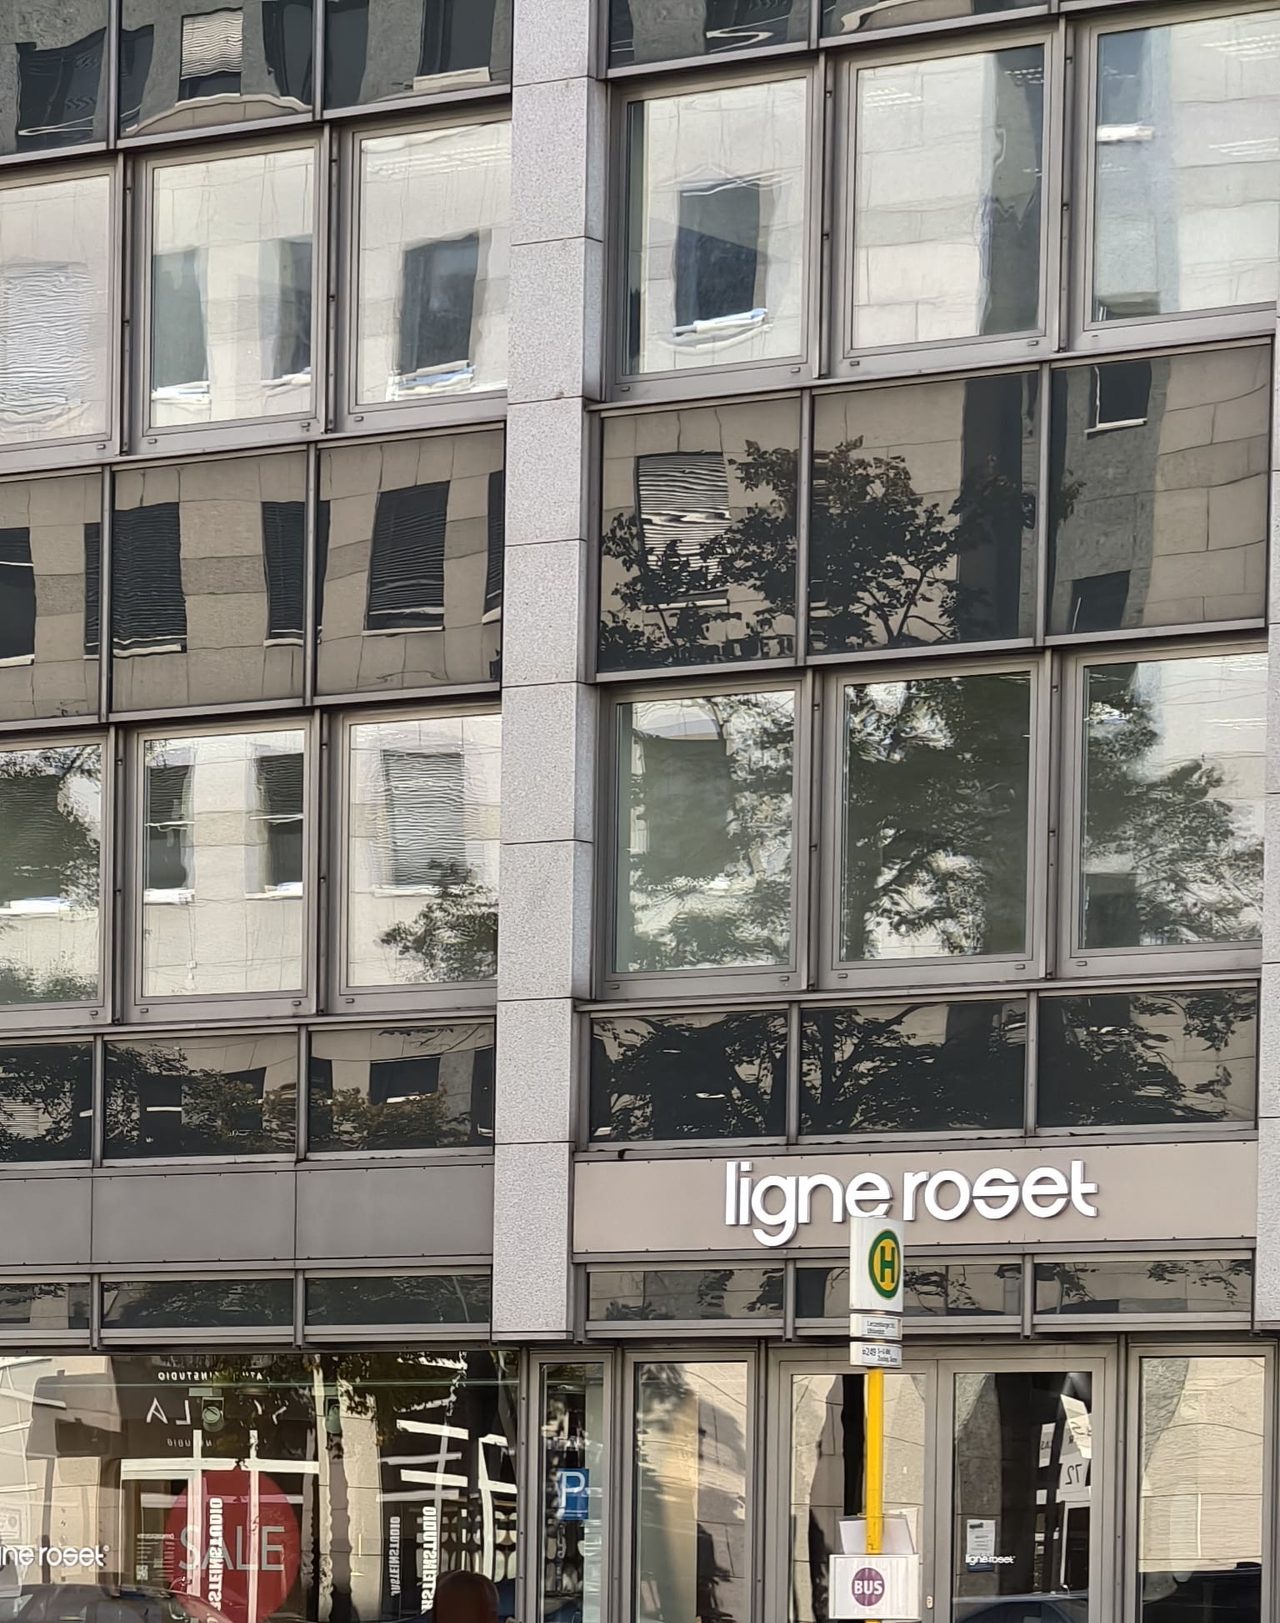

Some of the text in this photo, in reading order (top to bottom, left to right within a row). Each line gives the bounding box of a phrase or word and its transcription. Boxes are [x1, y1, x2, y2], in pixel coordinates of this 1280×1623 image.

[725, 1160, 1099, 1247] ligne roset
[880, 1245, 896, 1284] H
[38, 1545, 105, 1567] roset
[178, 1525, 285, 1571] SALE
[853, 1579, 883, 1595] BUS
